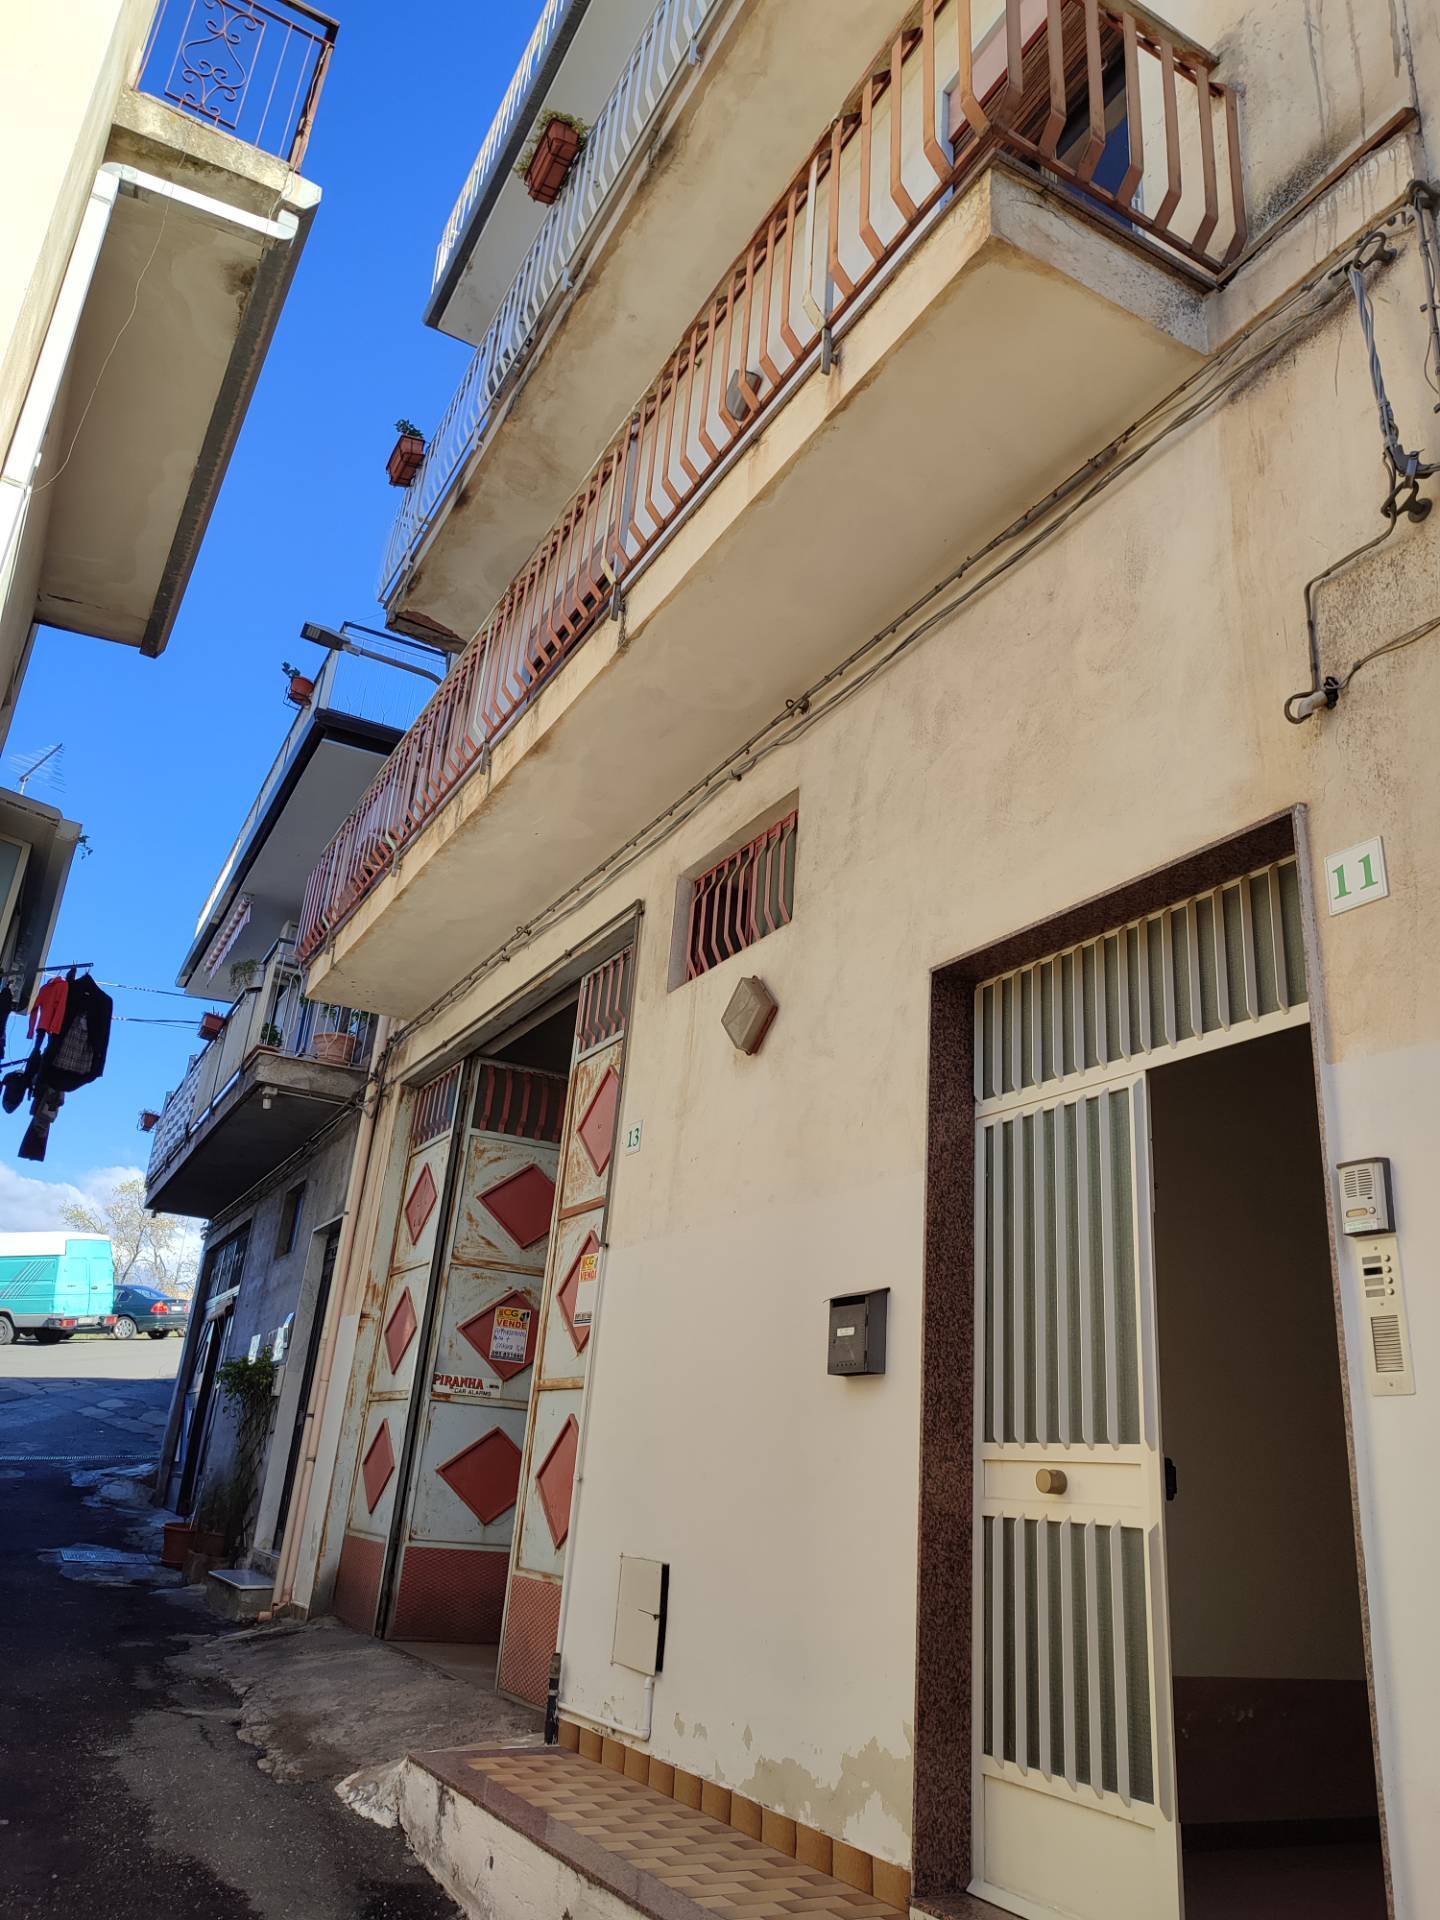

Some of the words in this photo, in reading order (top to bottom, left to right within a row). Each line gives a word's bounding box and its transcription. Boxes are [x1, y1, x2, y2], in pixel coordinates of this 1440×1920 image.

[1332, 853, 1378, 900] 11
[627, 1127, 640, 1148] 13
[496, 1318, 529, 1329] VENDE
[432, 1373, 484, 1390] PIRANHA
